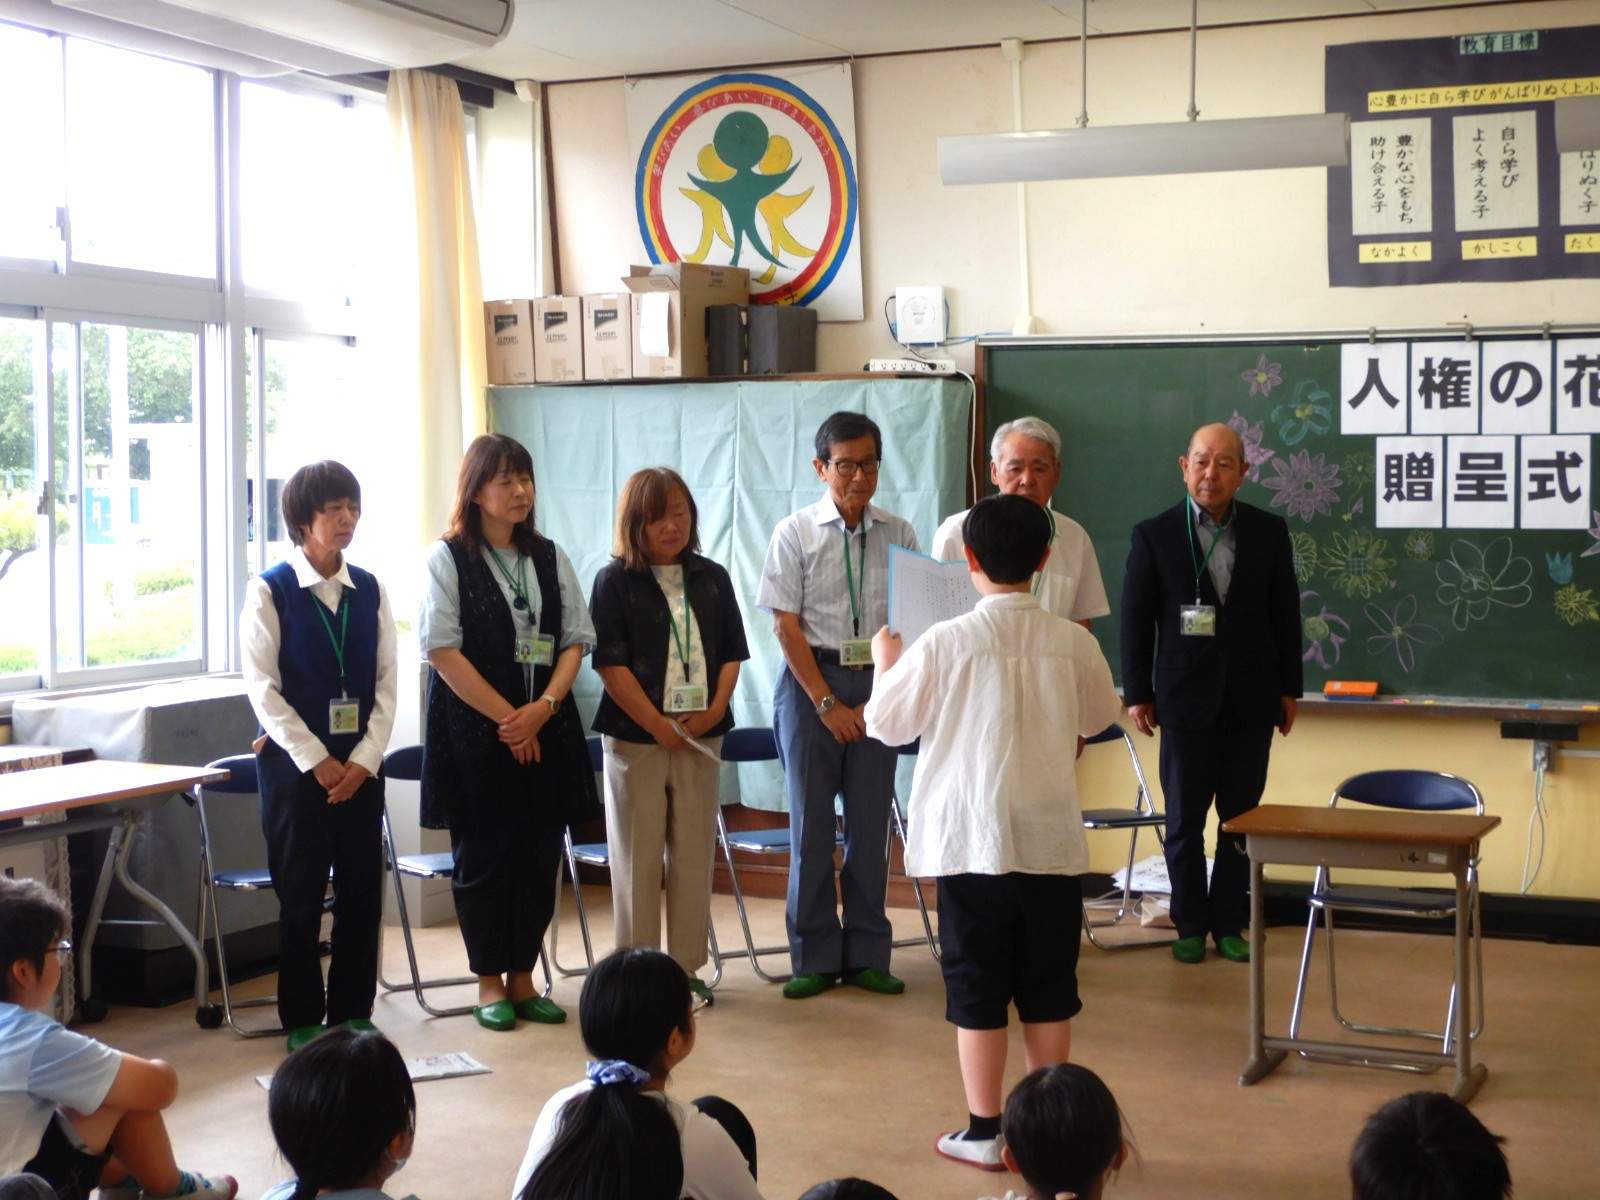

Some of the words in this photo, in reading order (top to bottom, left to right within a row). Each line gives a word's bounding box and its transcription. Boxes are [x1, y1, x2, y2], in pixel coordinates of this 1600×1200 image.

[1461, 34, 1537, 54] 教育目標
[1370, 136, 1387, 213] 助け合える子
[1395, 134, 1415, 224] 豊かな心をもち
[1470, 128, 1490, 219] よく考える子
[1501, 127, 1519, 188] 自ら学び
[1371, 245, 1418, 258] なかよく
[1473, 241, 1523, 255] かしこく
[1347, 354, 1600, 410] 人権の花
[1382, 450, 1584, 504] 贈呈式
